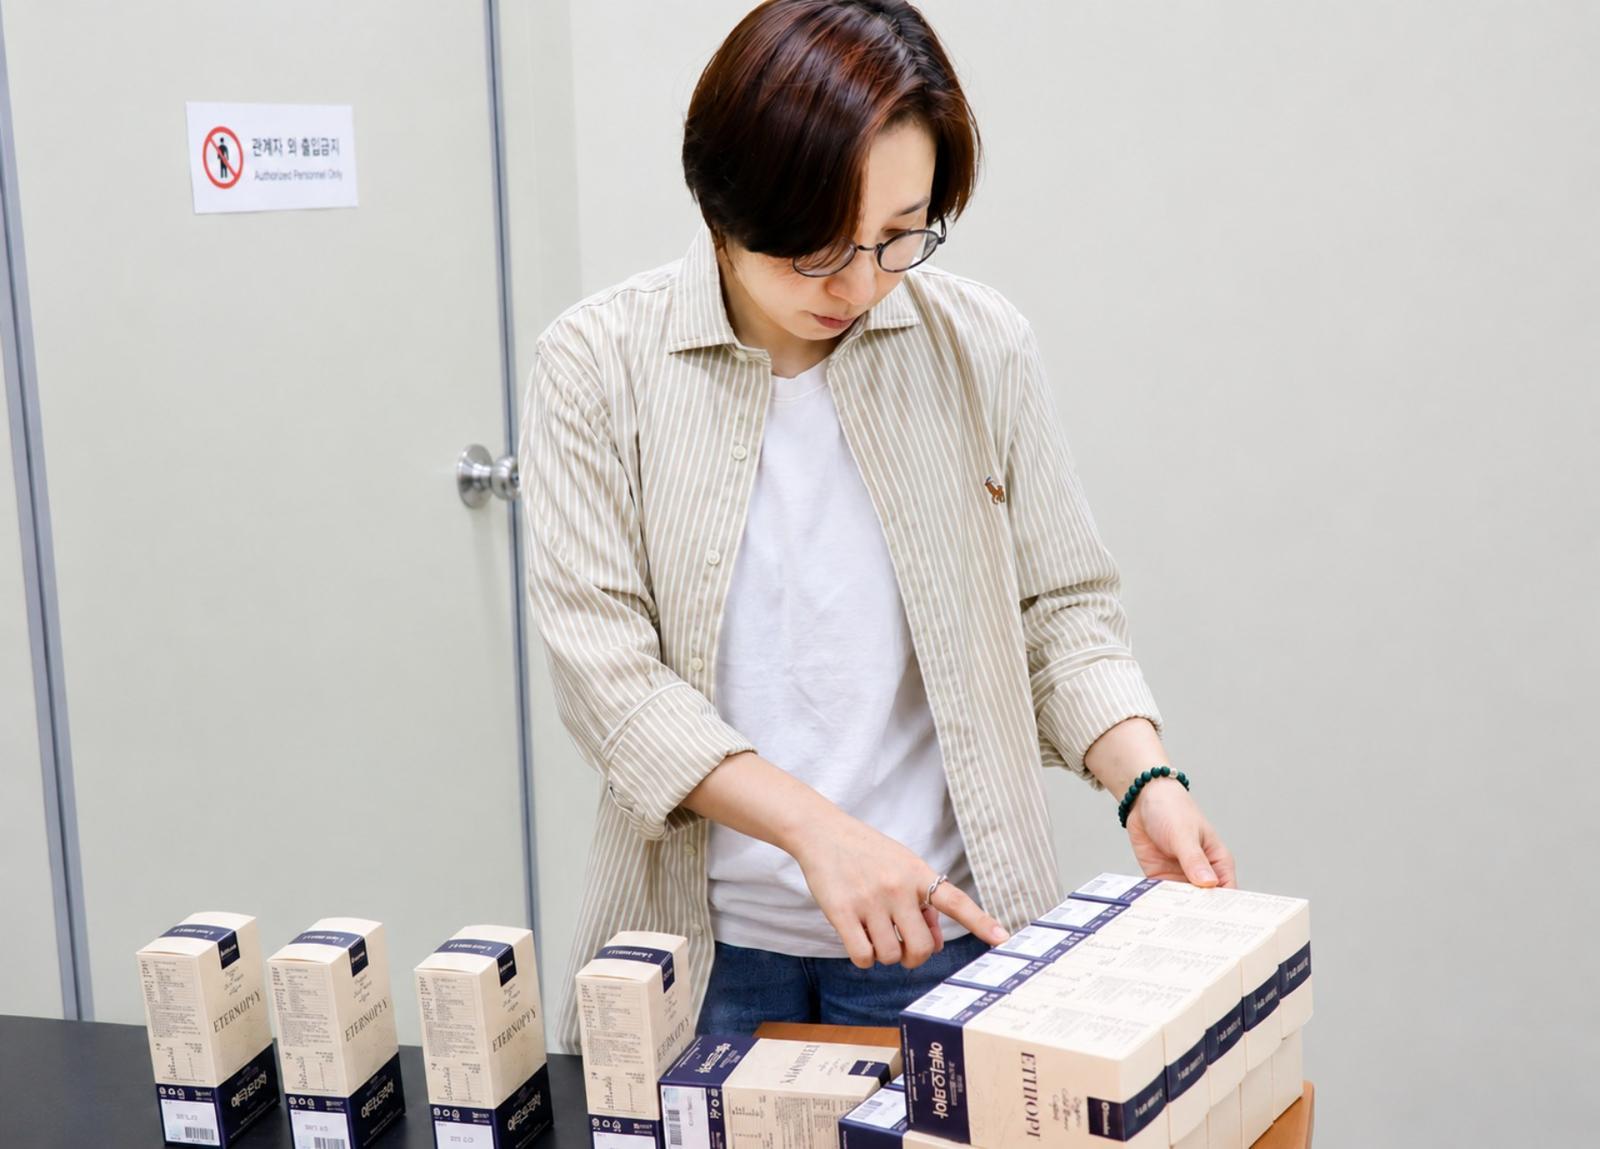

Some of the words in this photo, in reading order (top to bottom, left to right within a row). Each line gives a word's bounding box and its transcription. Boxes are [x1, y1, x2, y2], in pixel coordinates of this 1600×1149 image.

[252, 137, 283, 157] 관계자
[287, 137, 297, 156] 외
[301, 137, 340, 157] 출입금지
[254, 169, 292, 181] Authorized
[294, 168, 326, 180] Personnel
[327, 168, 343, 181] Only
